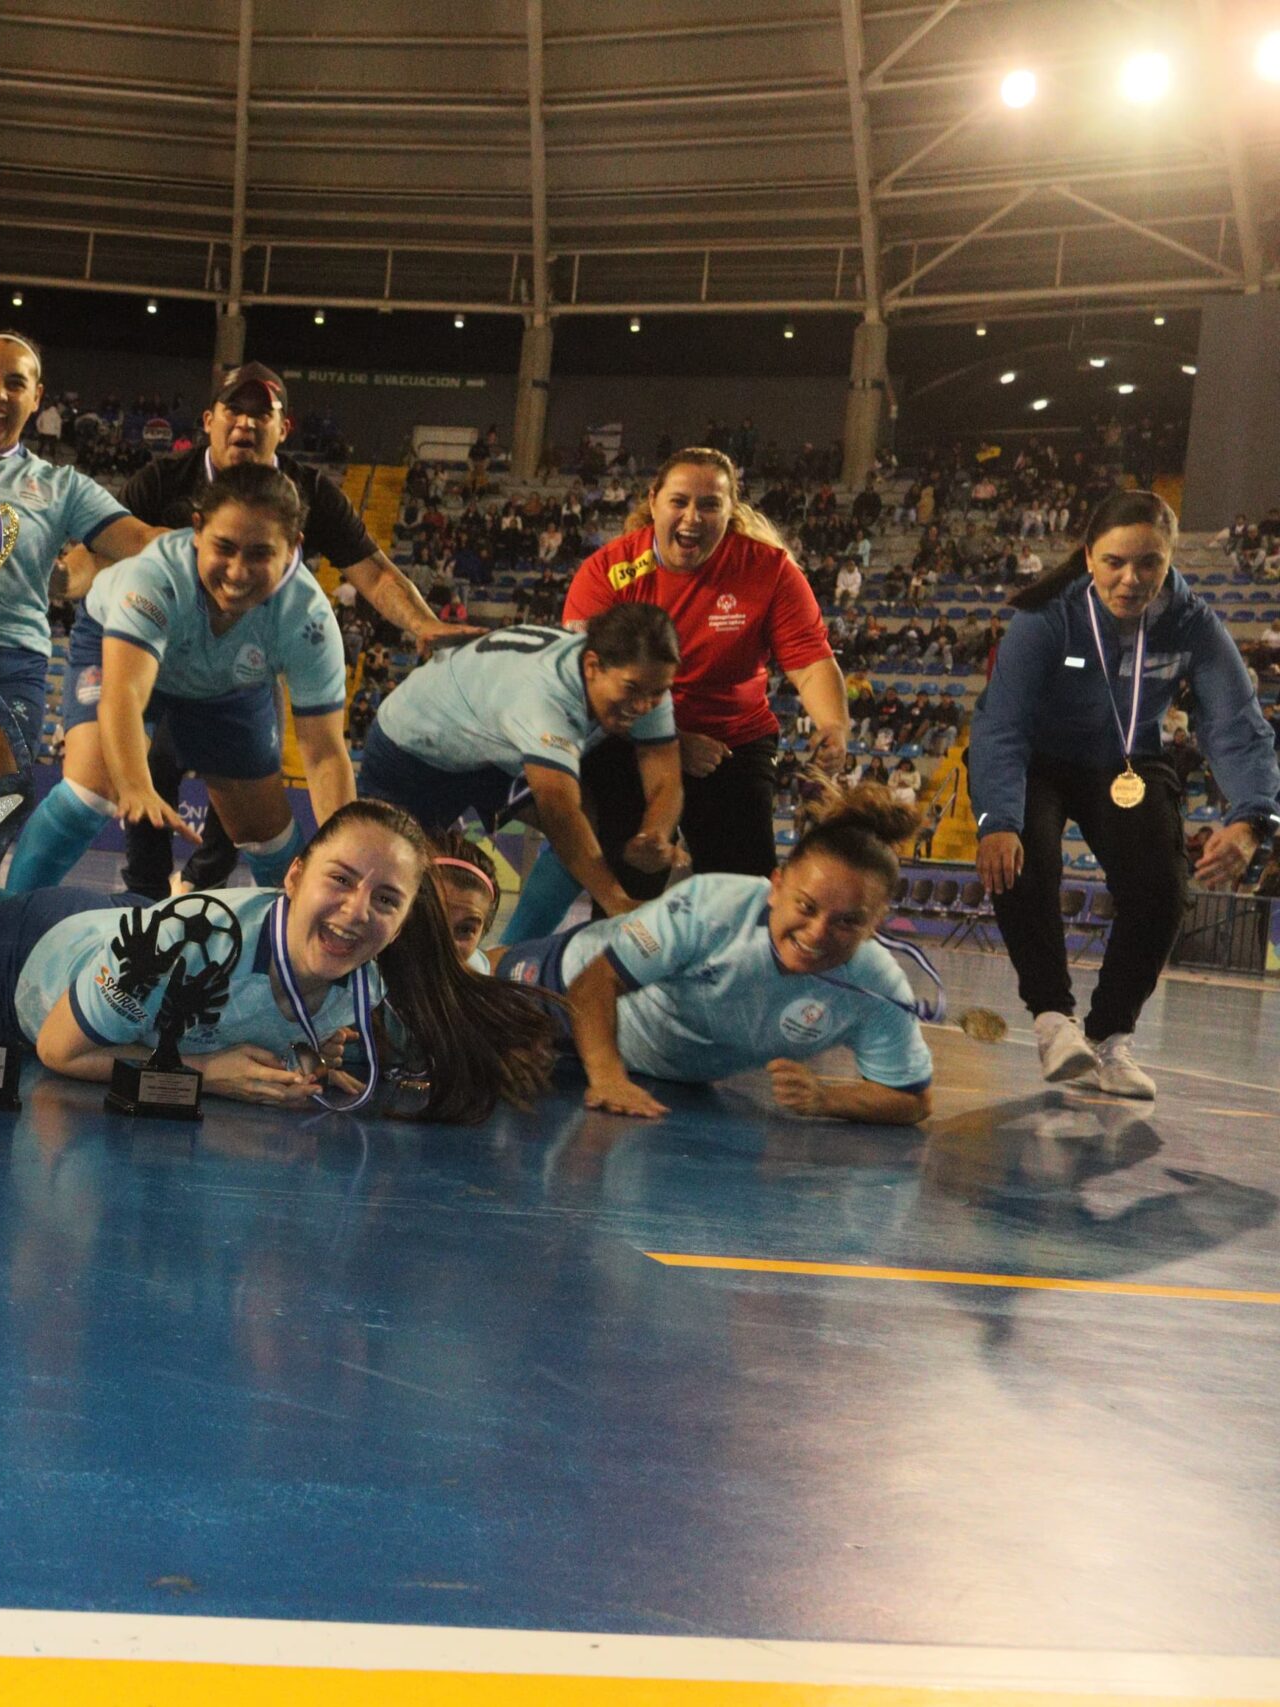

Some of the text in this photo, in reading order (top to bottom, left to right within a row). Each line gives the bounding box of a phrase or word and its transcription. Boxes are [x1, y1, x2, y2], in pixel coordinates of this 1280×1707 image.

[308, 371, 462, 388] RUTA DE EVACUACION
